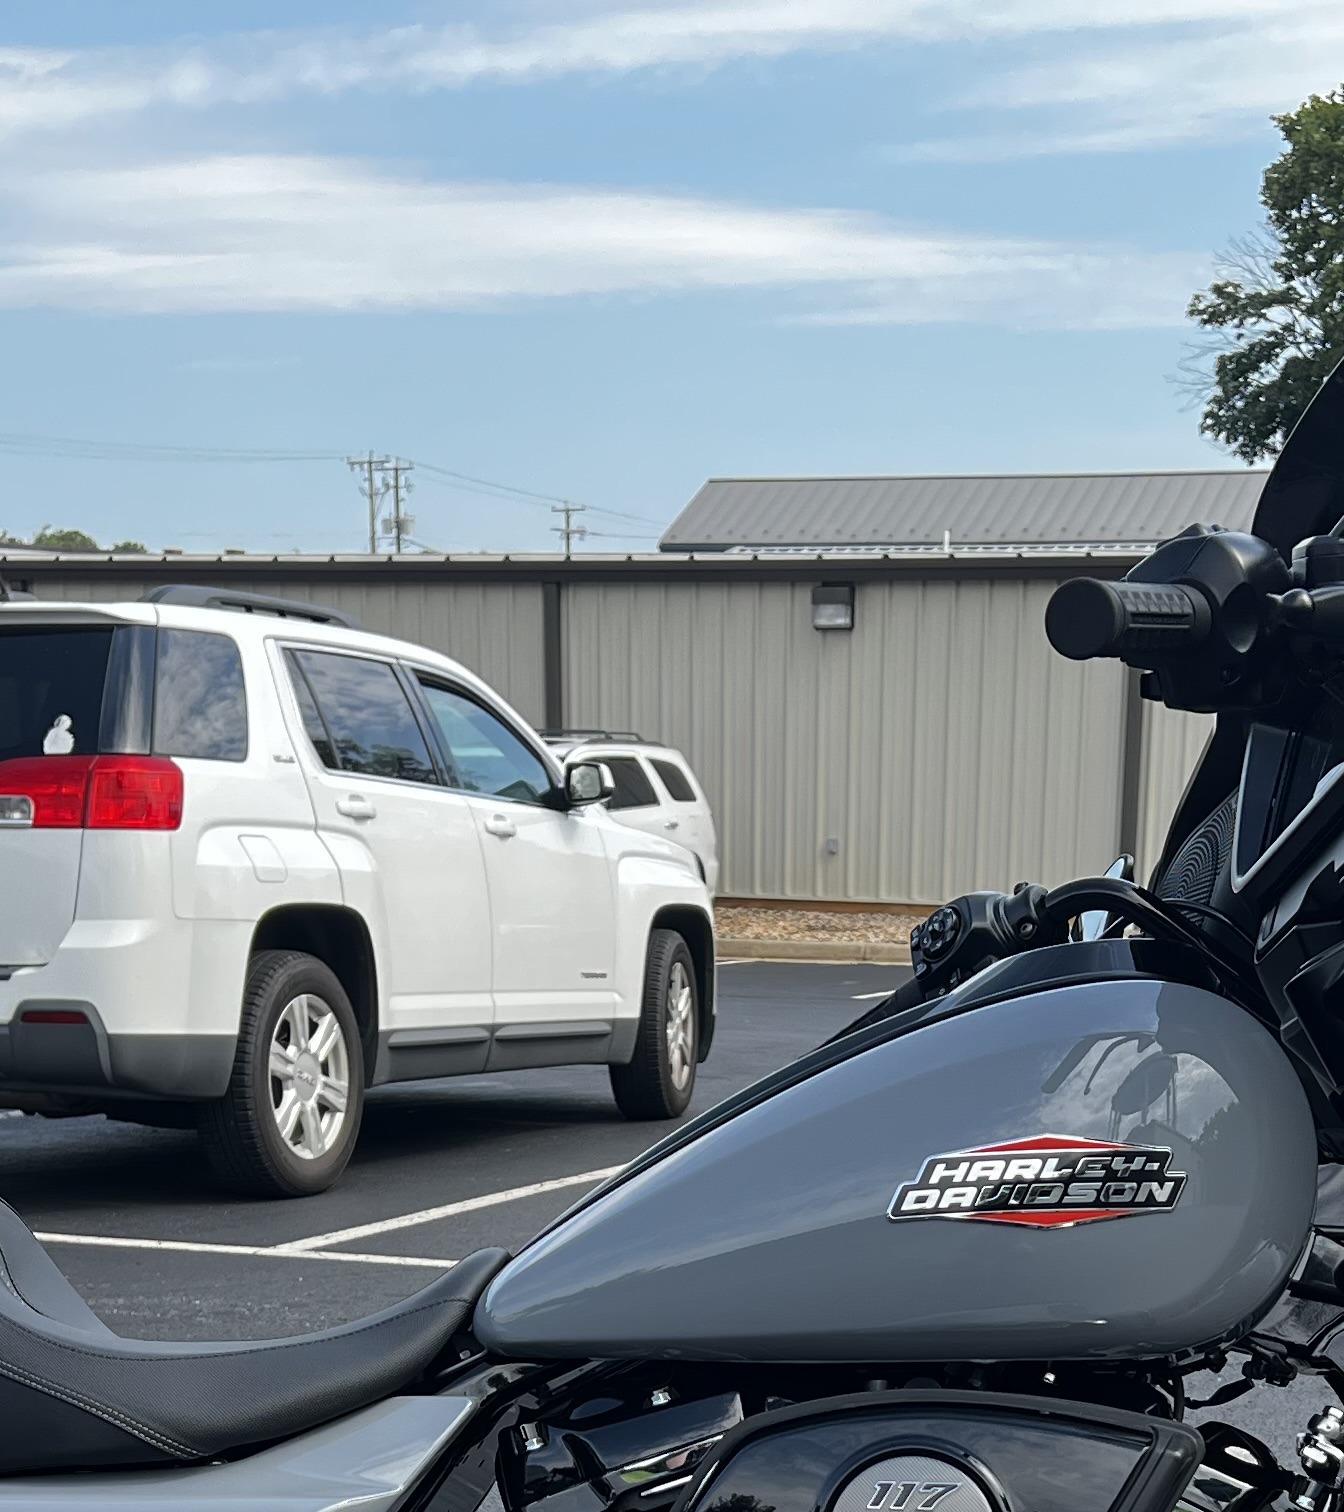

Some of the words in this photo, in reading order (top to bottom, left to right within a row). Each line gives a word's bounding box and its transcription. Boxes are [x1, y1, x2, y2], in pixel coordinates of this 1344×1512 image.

[929, 1156, 1161, 1185] HARLEY-
[900, 1181, 1175, 1212] DAVIDSON
[866, 1480, 963, 1511] 117
